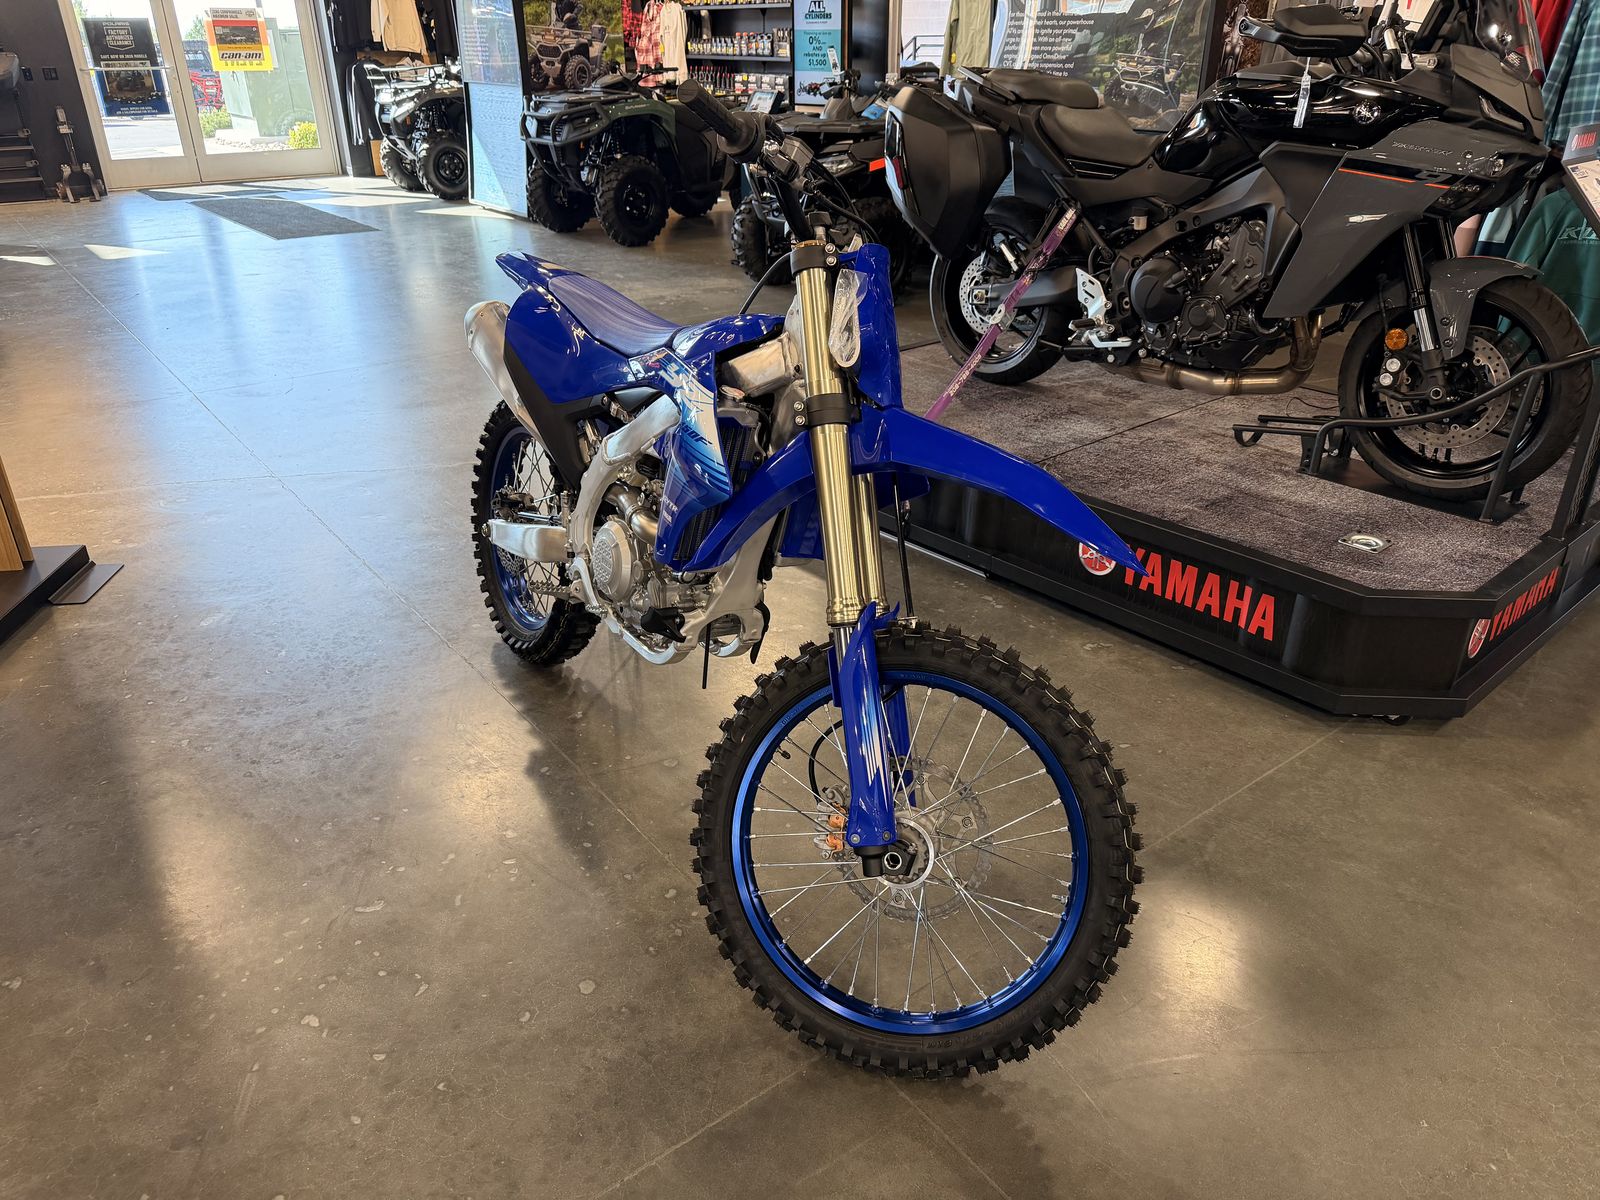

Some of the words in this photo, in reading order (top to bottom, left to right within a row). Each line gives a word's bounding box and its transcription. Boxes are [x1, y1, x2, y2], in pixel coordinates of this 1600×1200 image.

[809, 0, 825, 12] ALL
[1067, 18, 1094, 26] powerhouse
[808, 36, 821, 45] 0%
[1052, 44, 1073, 52] powerful
[808, 58, 827, 66] $1,500
[1065, 61, 1075, 69] and
[1489, 565, 1559, 641] YAMAHA
